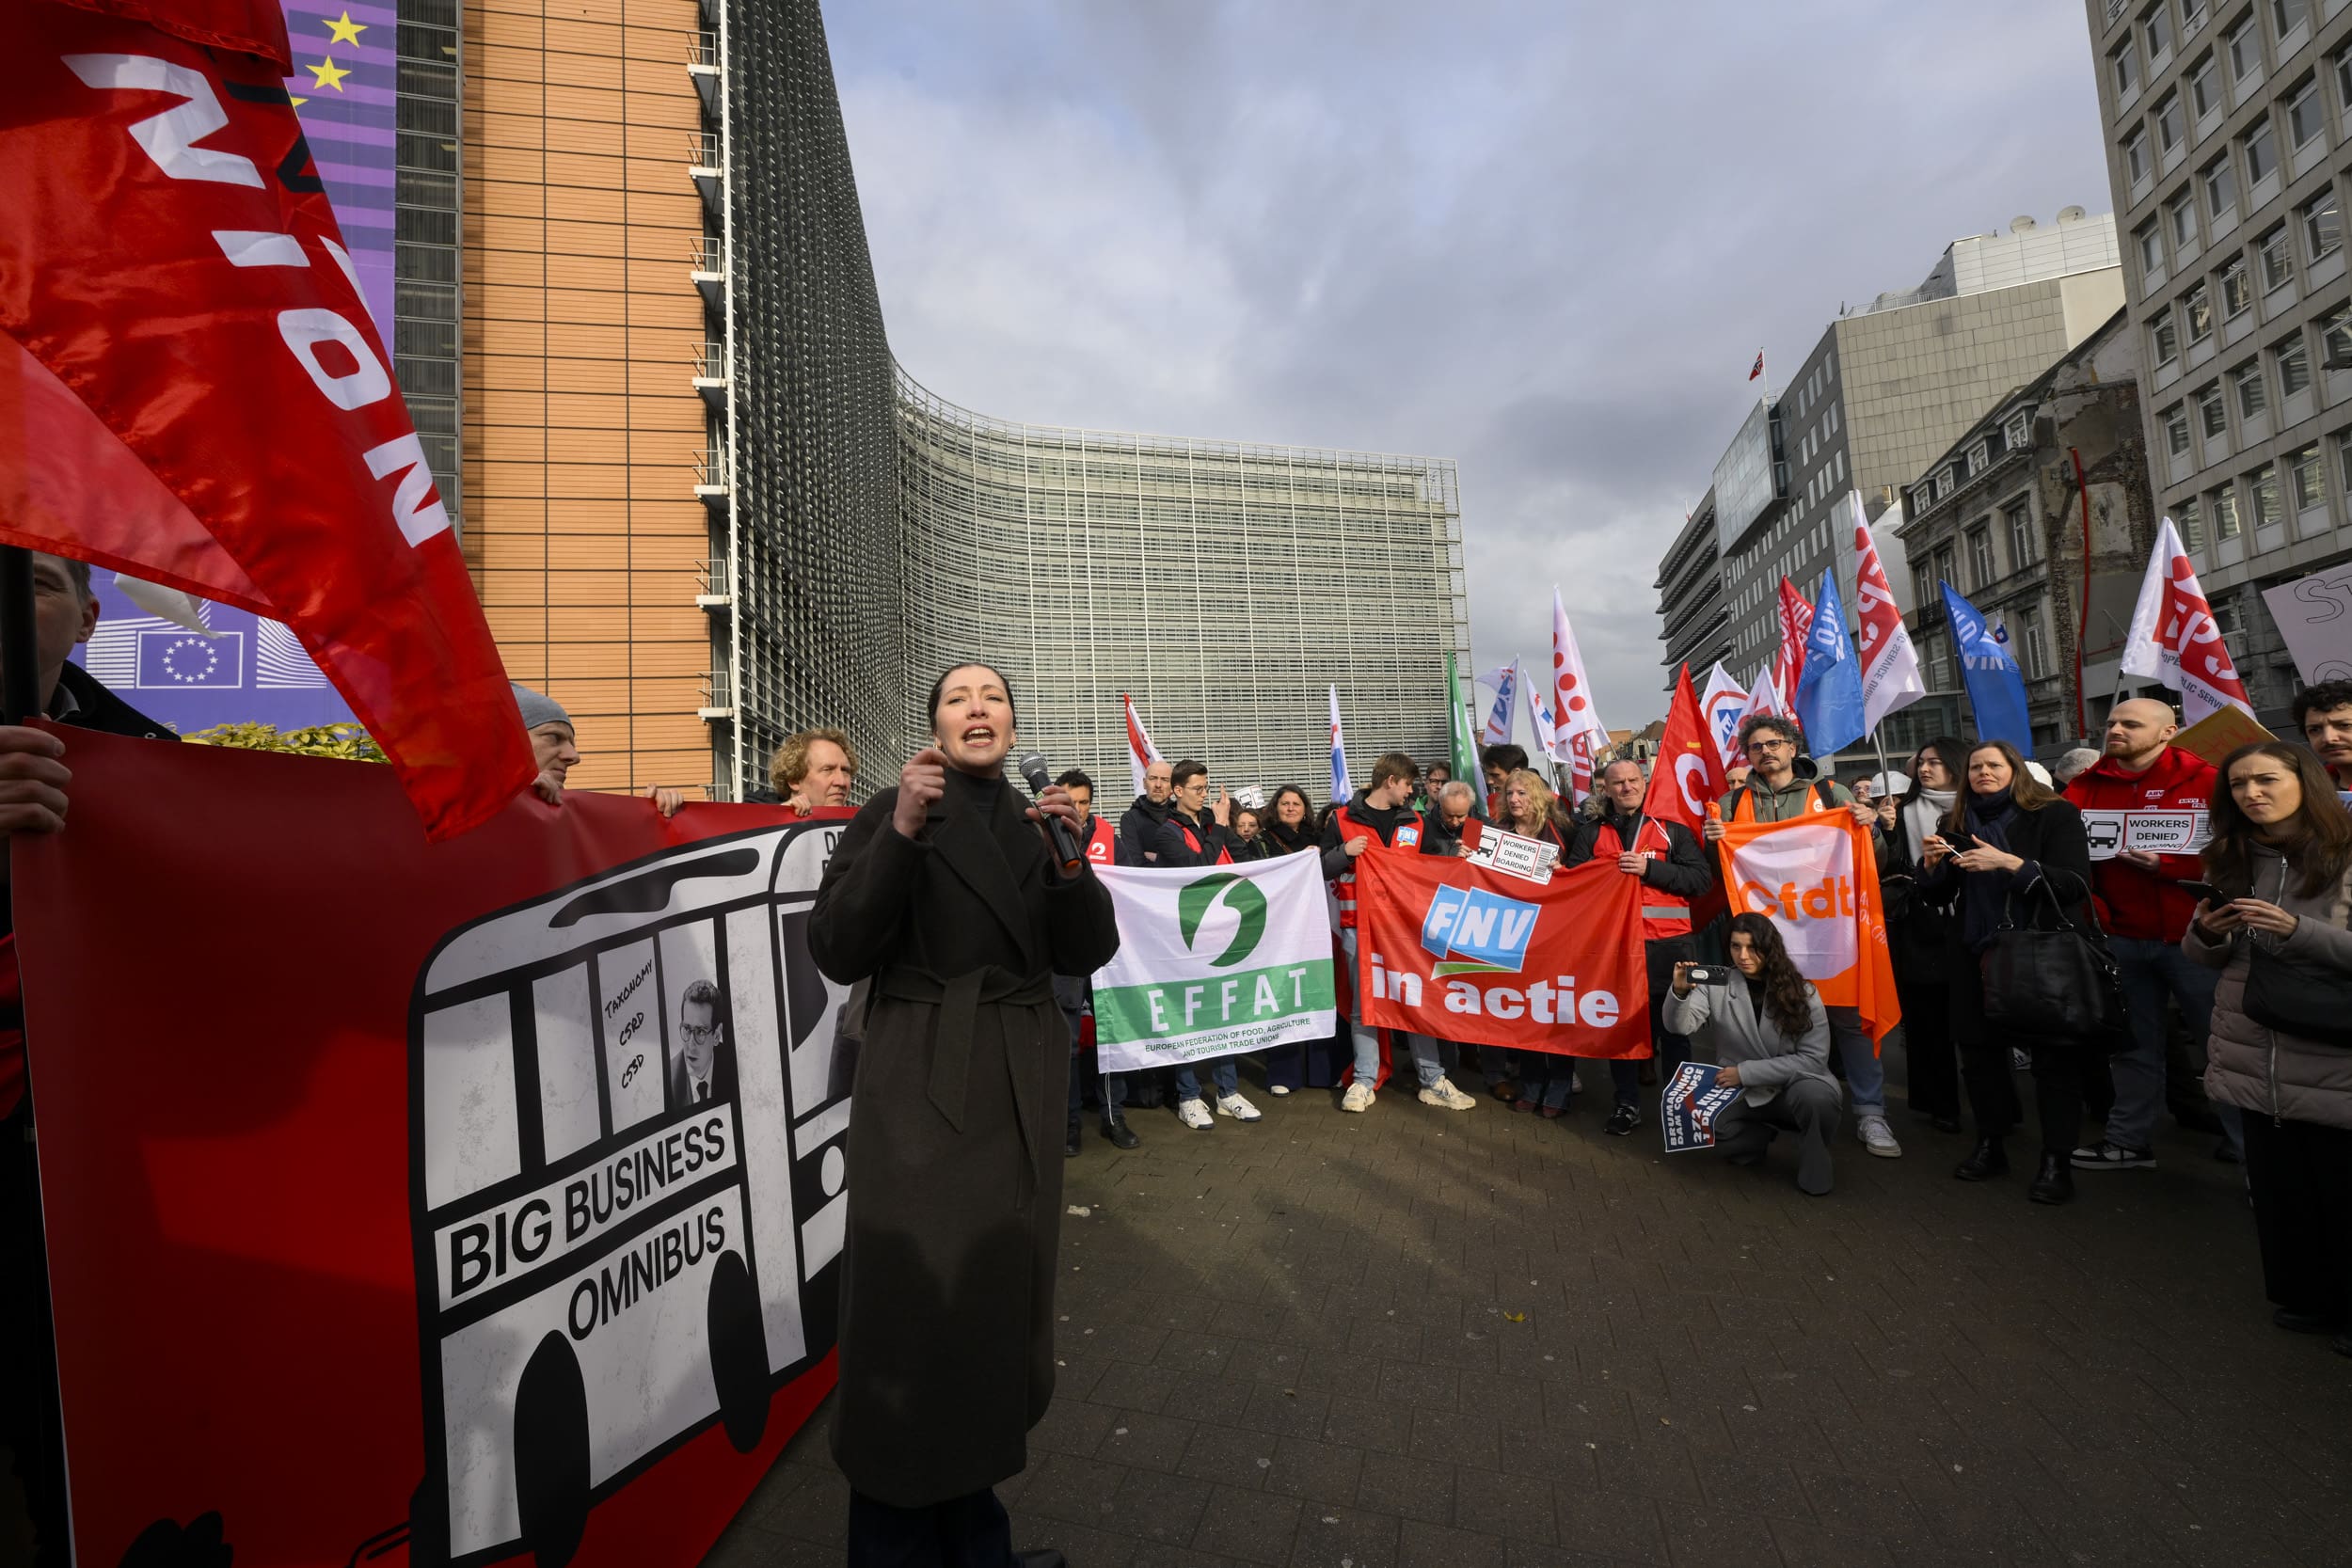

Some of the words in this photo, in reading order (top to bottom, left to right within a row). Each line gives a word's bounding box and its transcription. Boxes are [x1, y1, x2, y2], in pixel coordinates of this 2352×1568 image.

[1398, 829, 1418, 843] FNV
[2129, 819, 2189, 828] WORKERS
[2137, 832, 2179, 841] DENIED
[1502, 839, 1537, 854] WORKERS
[1503, 849, 1530, 862] DENIED
[1495, 857, 1532, 873] BOARDING
[1426, 901, 1534, 950] FNV
[605, 958, 653, 1019] TAXONOMY
[1147, 967, 1307, 1032] EFFAT
[1371, 953, 1422, 1007] in
[1444, 975, 1620, 1028] actie
[619, 1011, 644, 1046] CSRD
[1145, 1040, 1184, 1052] EUROPEAN
[1184, 1033, 1229, 1047] FEDERATION
[1230, 1031, 1240, 1040] OF
[1242, 1027, 1266, 1037] FOOD,
[1266, 1018, 1311, 1033] AGRICULTURE
[1183, 1050, 1196, 1058] AND
[1196, 1042, 1228, 1055] TOURISM
[1229, 1039, 1255, 1051] TRADE
[1256, 1034, 1279, 1045] UNIONS
[1666, 1066, 1694, 1146] BRUMADINHO
[1674, 1068, 1705, 1110] COLLAPSE
[1675, 1115, 1684, 1145] DAM
[1691, 1109, 1703, 1143] 272
[1701, 1101, 1722, 1126] DEAD
[450, 1198, 552, 1300] BIG
[564, 1117, 725, 1243] BUSINESS
[567, 1206, 725, 1341] OMNIBUS
